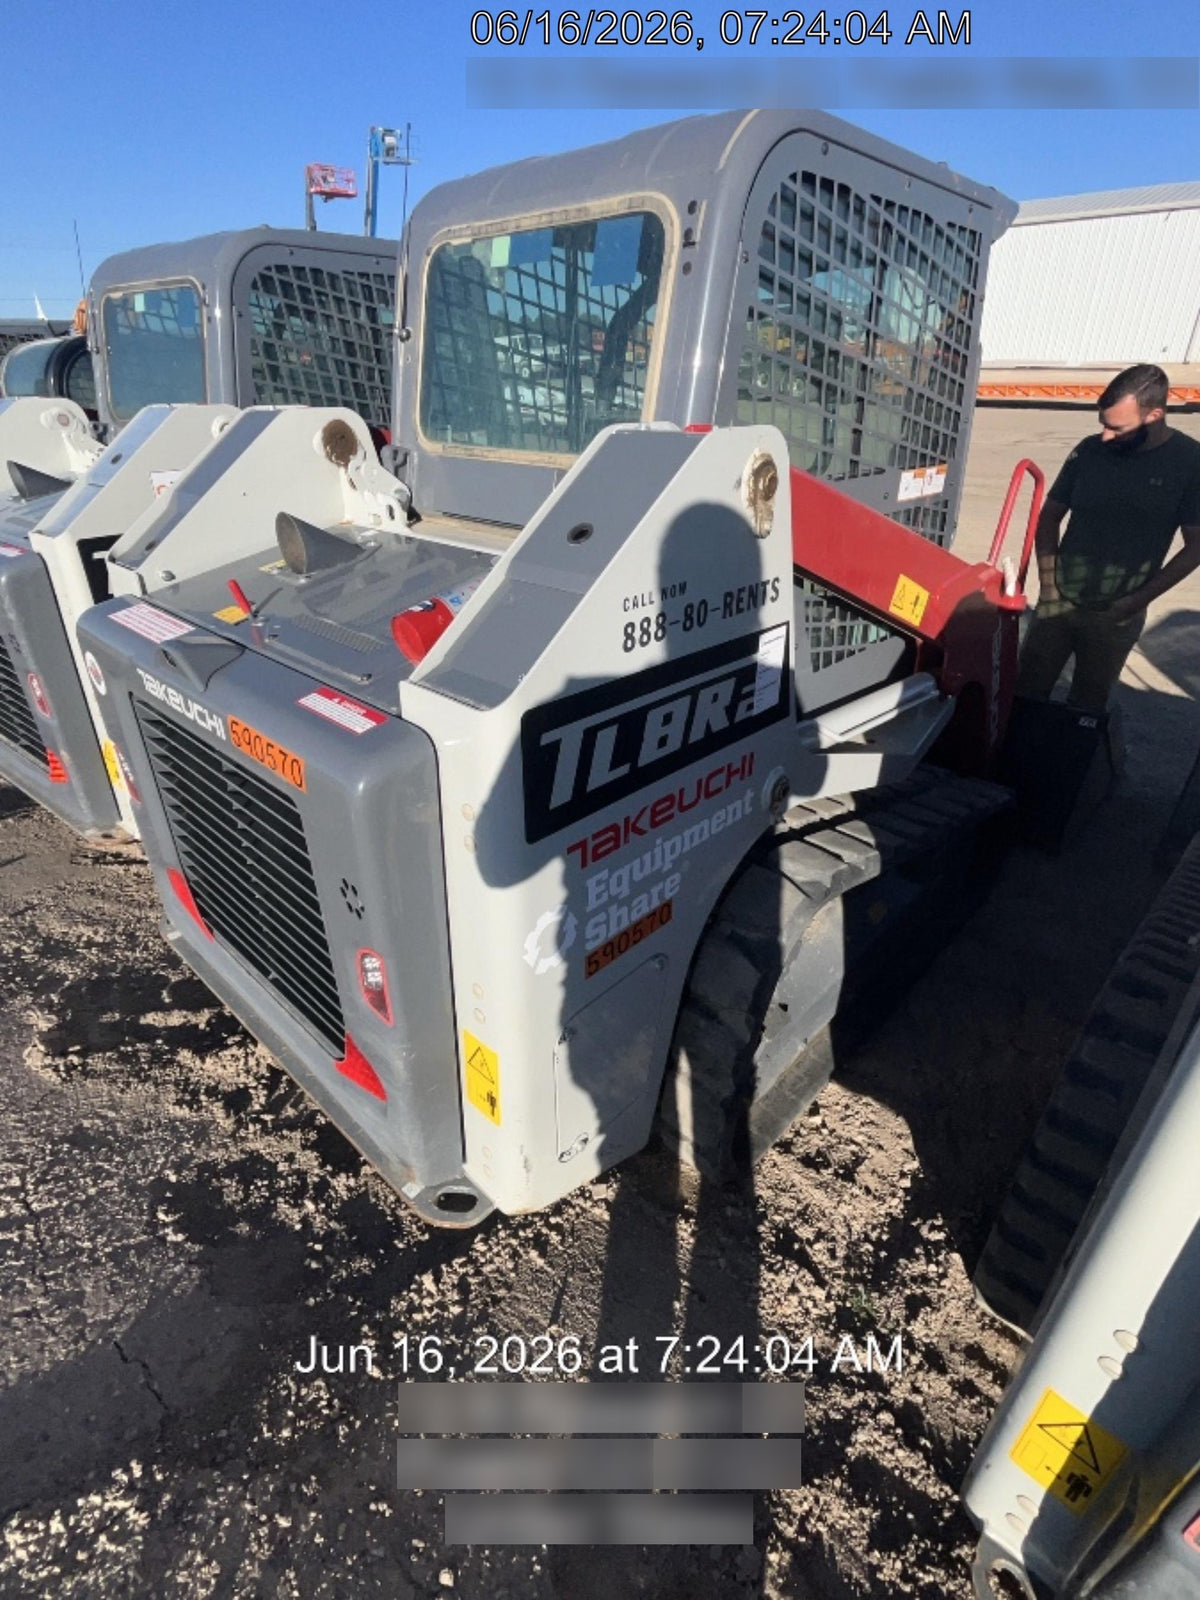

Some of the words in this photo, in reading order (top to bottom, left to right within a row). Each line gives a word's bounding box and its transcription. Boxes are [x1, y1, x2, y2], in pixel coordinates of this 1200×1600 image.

[621, 576, 780, 653] 888-80-RENTS
[622, 588, 656, 613] CALL
[660, 580, 688, 602] NOW
[229, 718, 304, 790] 590570
[585, 788, 756, 913] Equipment
[584, 871, 682, 951] Share
[586, 901, 674, 977] 590570
